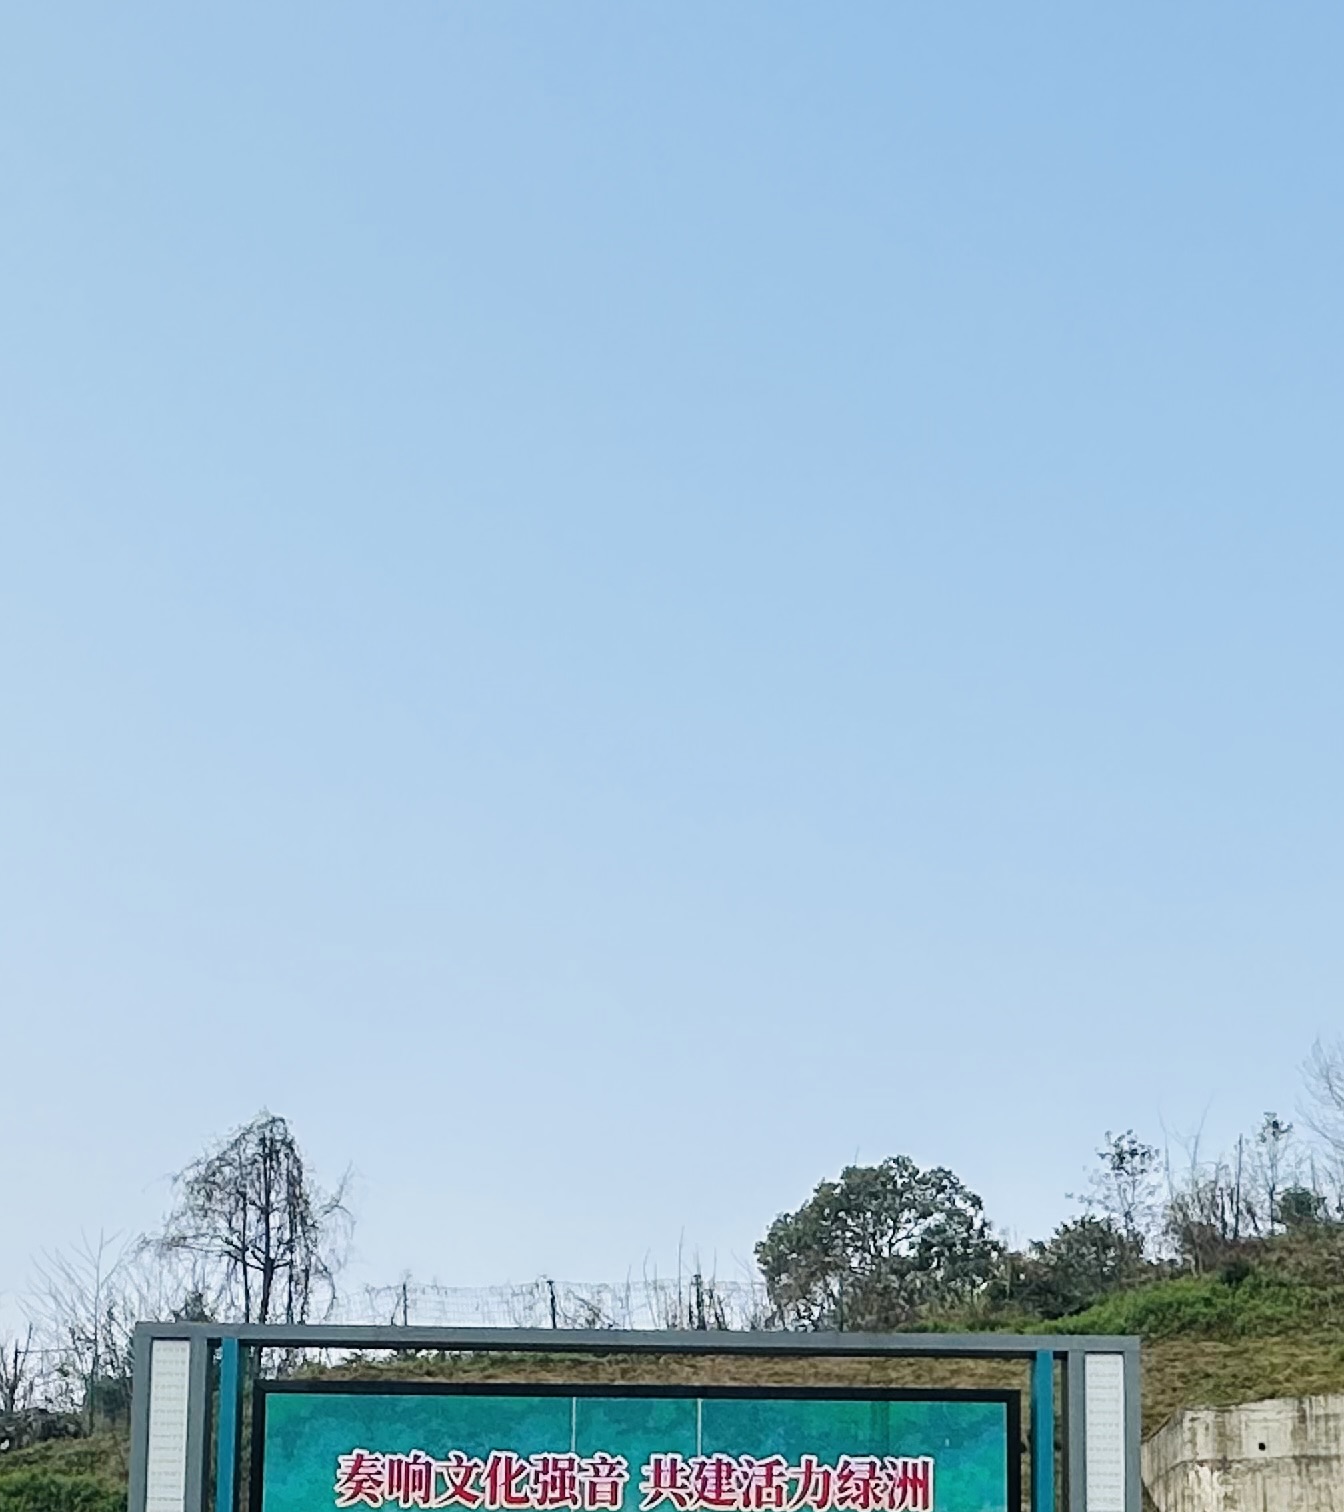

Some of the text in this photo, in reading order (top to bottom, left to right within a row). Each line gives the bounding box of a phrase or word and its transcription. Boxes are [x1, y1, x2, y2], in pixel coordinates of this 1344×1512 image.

[336, 1449, 933, 1512] 奏响文化强音 共建活力绿洲
